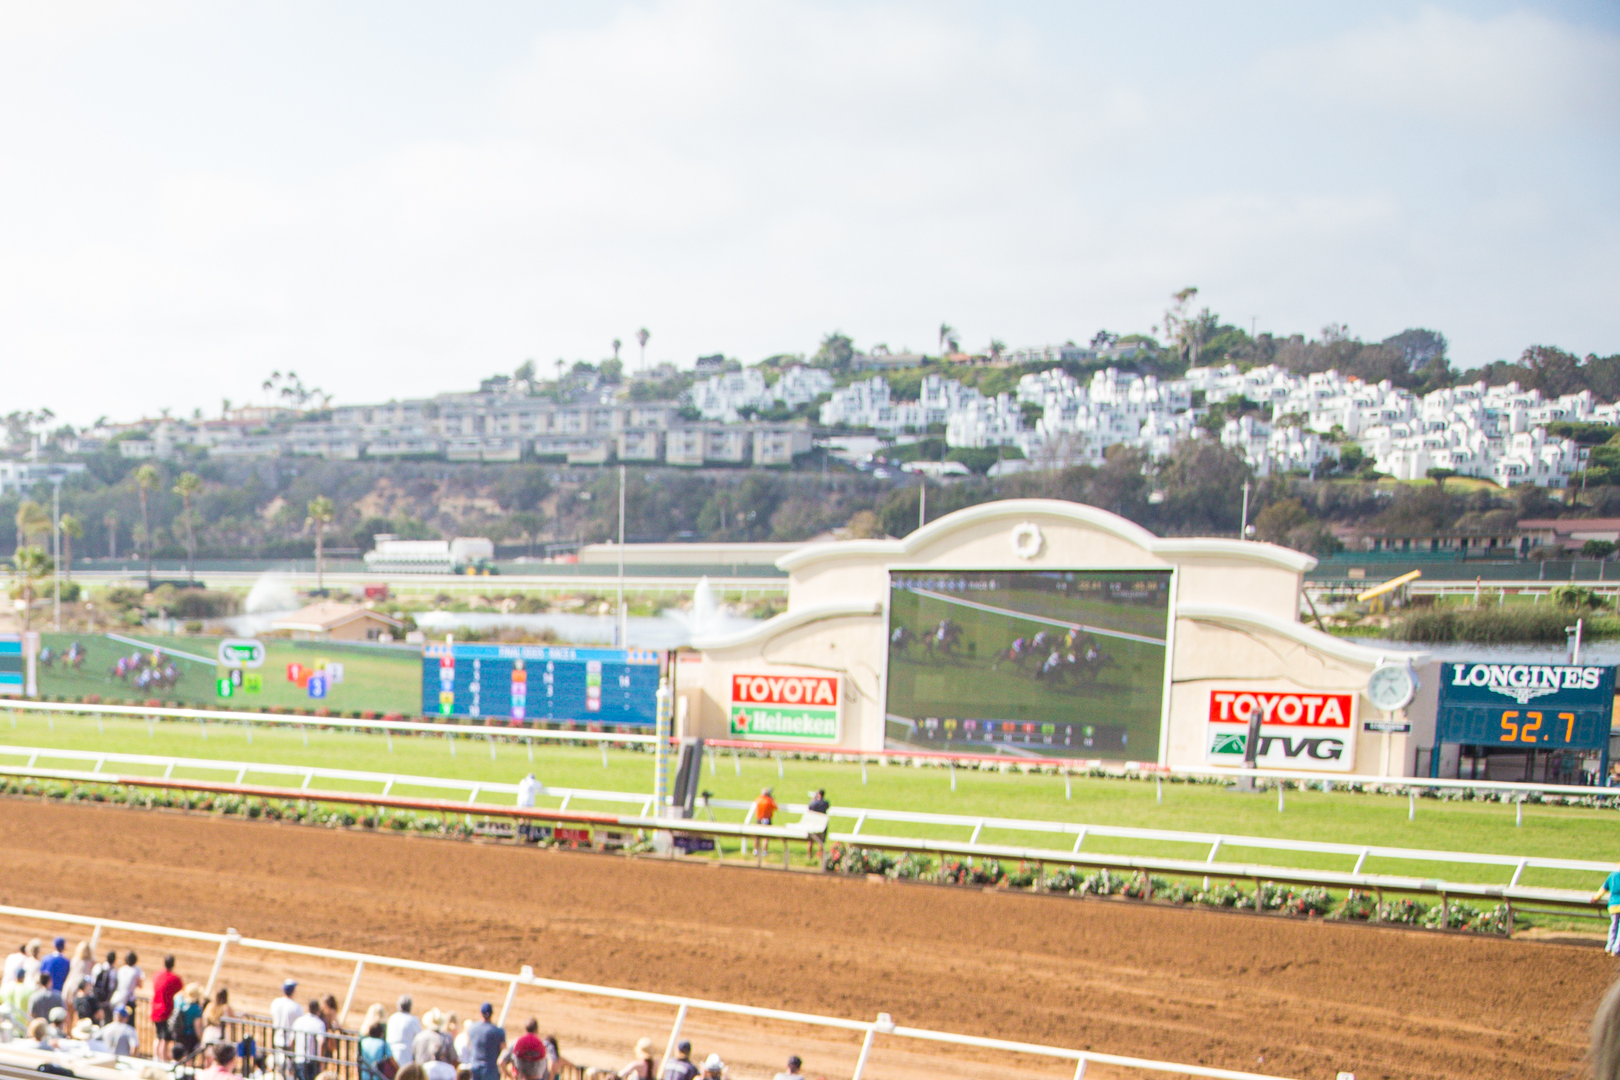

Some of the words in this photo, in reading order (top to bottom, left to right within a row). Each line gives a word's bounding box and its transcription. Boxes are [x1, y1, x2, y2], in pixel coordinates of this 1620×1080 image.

[736, 676, 835, 704] TOYOTA
[1452, 664, 1601, 690] LONGINES
[752, 710, 836, 735] Heineken
[1215, 693, 1345, 725] TOYOTA
[1500, 710, 1575, 743] 52.7
[1257, 736, 1344, 760] TVG
